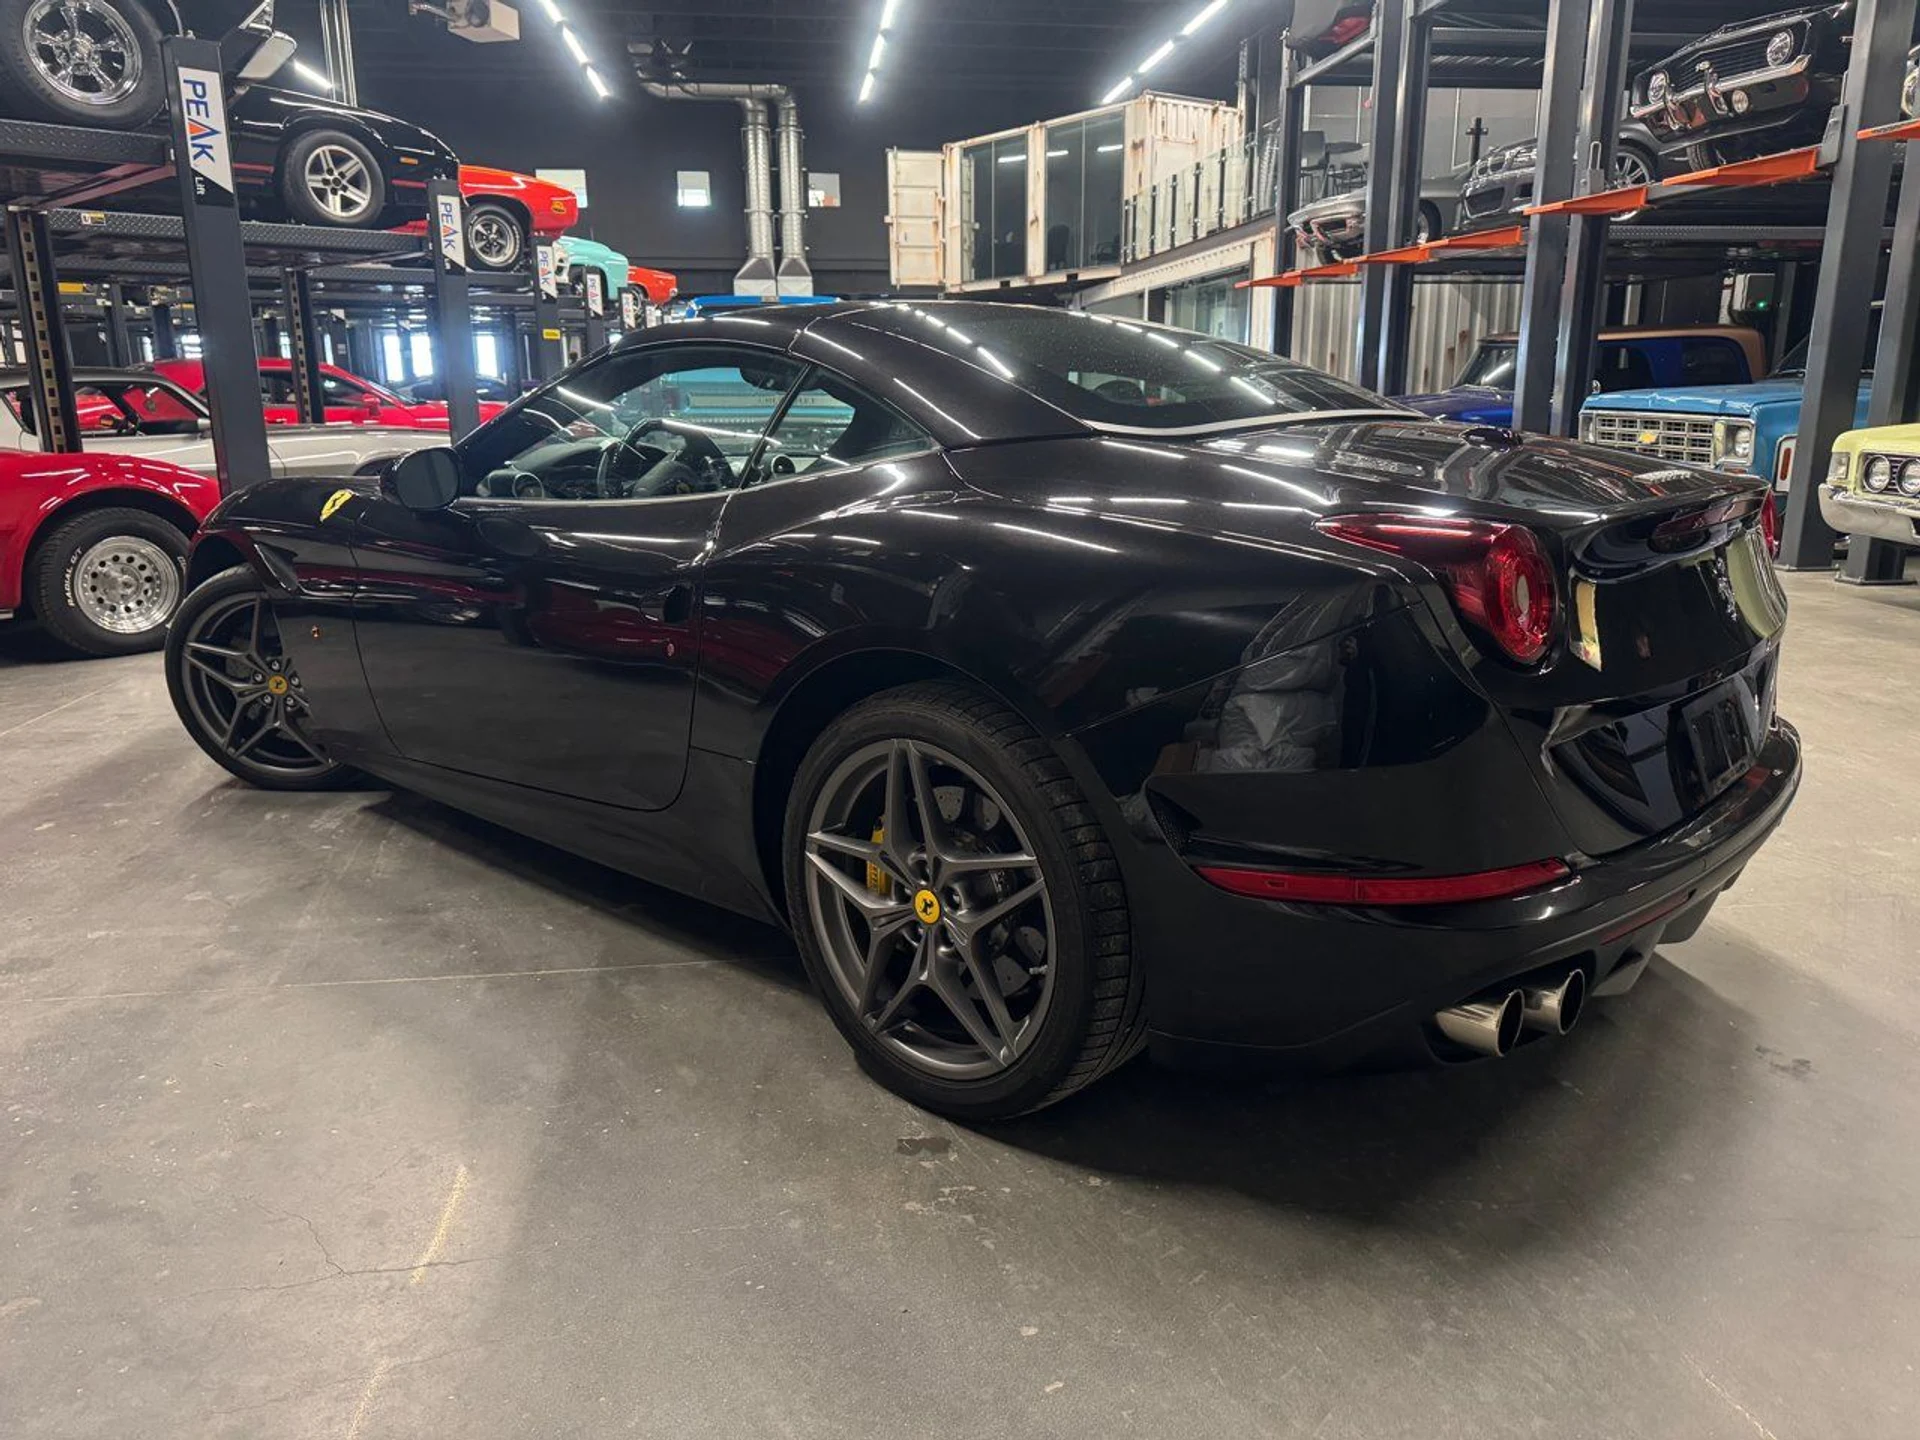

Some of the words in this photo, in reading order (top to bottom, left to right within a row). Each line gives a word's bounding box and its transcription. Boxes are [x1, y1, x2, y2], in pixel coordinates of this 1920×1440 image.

[183, 79, 221, 162] PEAK
[440, 202, 459, 249] PEAK
[539, 250, 552, 285] PEAK
